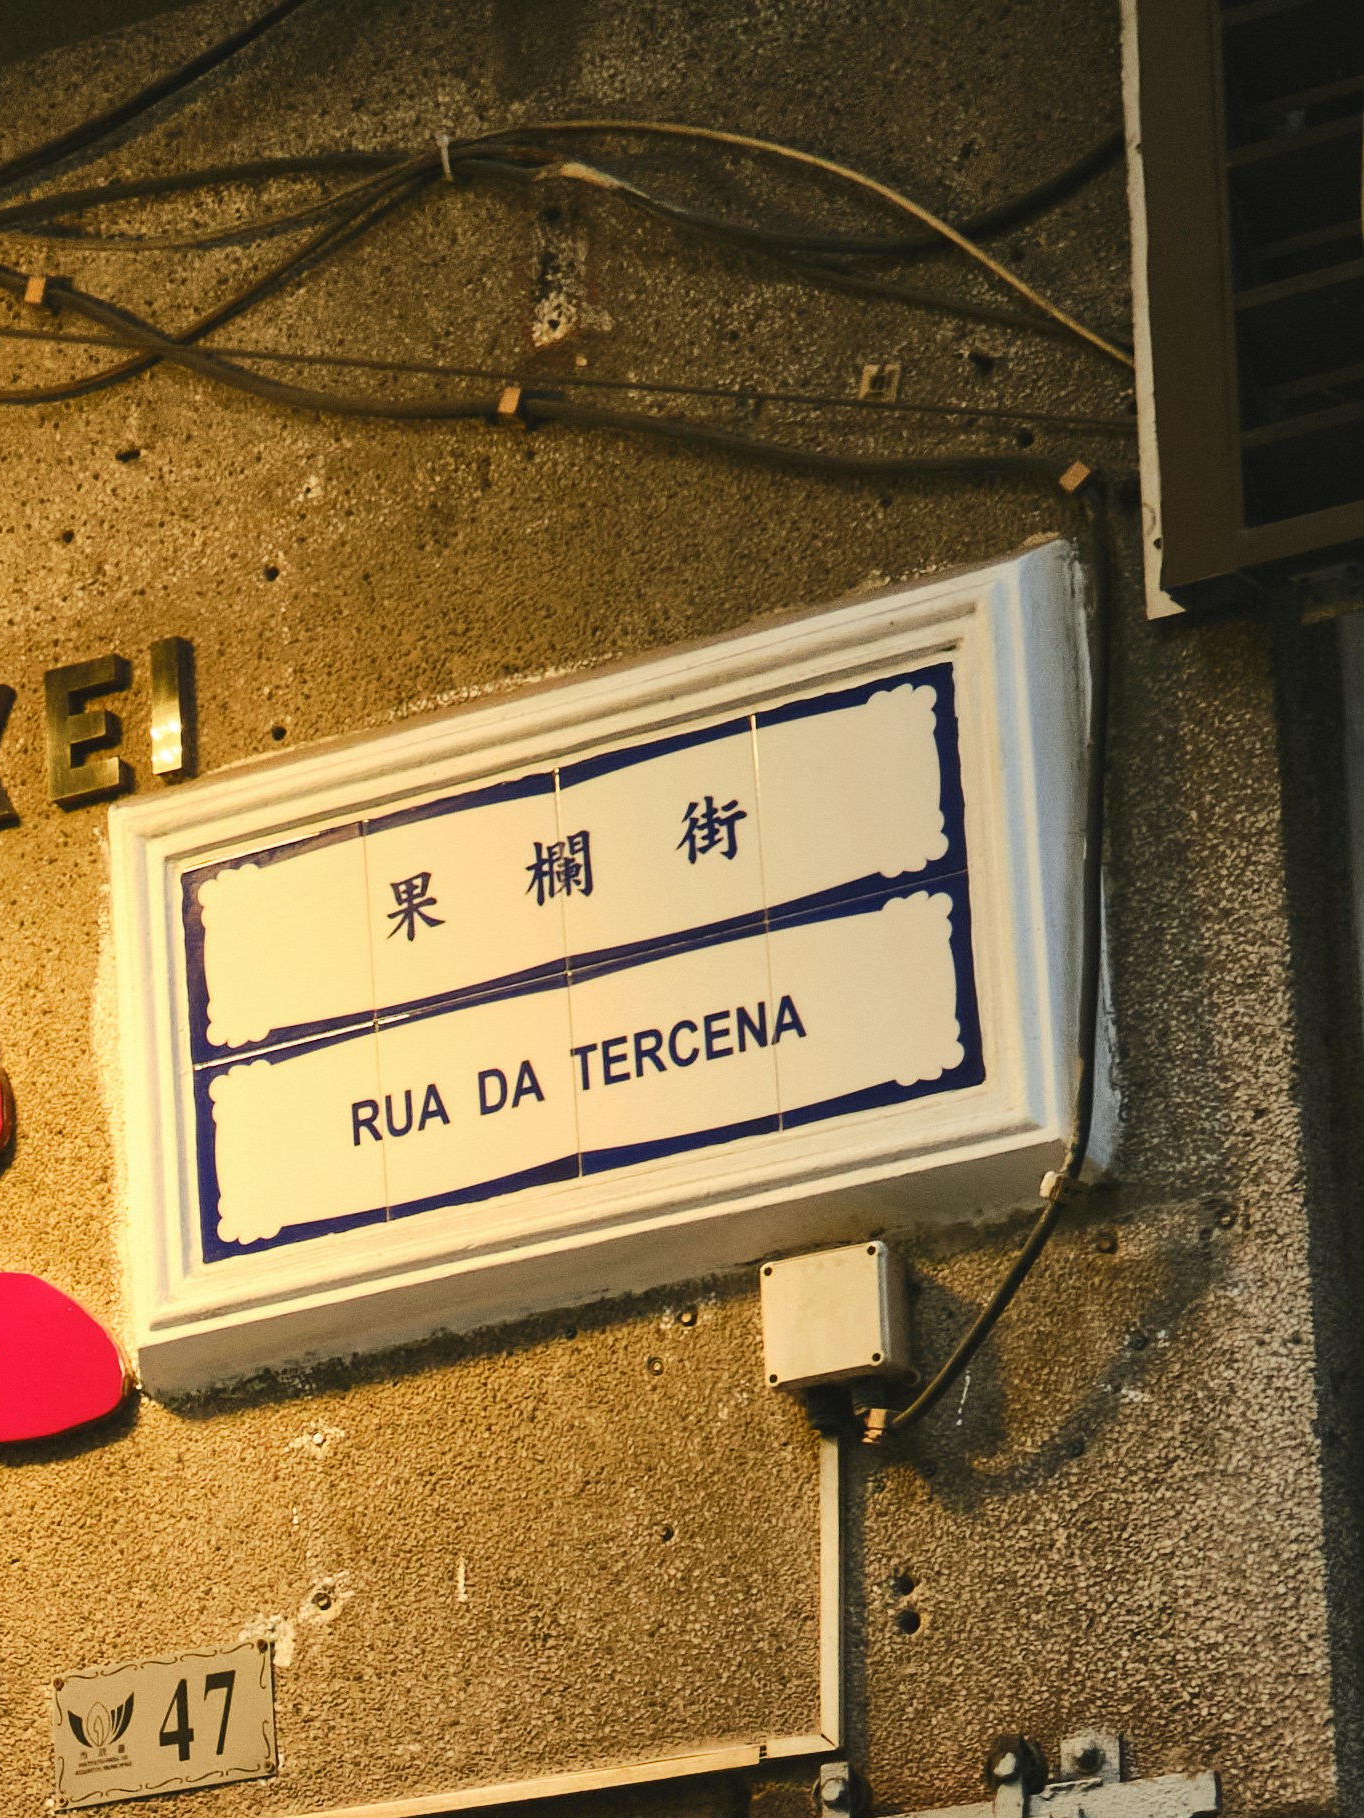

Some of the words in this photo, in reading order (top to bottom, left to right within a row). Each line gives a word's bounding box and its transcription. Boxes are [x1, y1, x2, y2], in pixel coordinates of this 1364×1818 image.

[385, 795, 747, 942] 果欄街
[349, 1082, 451, 1147] RUA
[478, 1066, 545, 1117] DA
[571, 994, 808, 1092] TERCENA
[159, 1669, 236, 1762] 47
